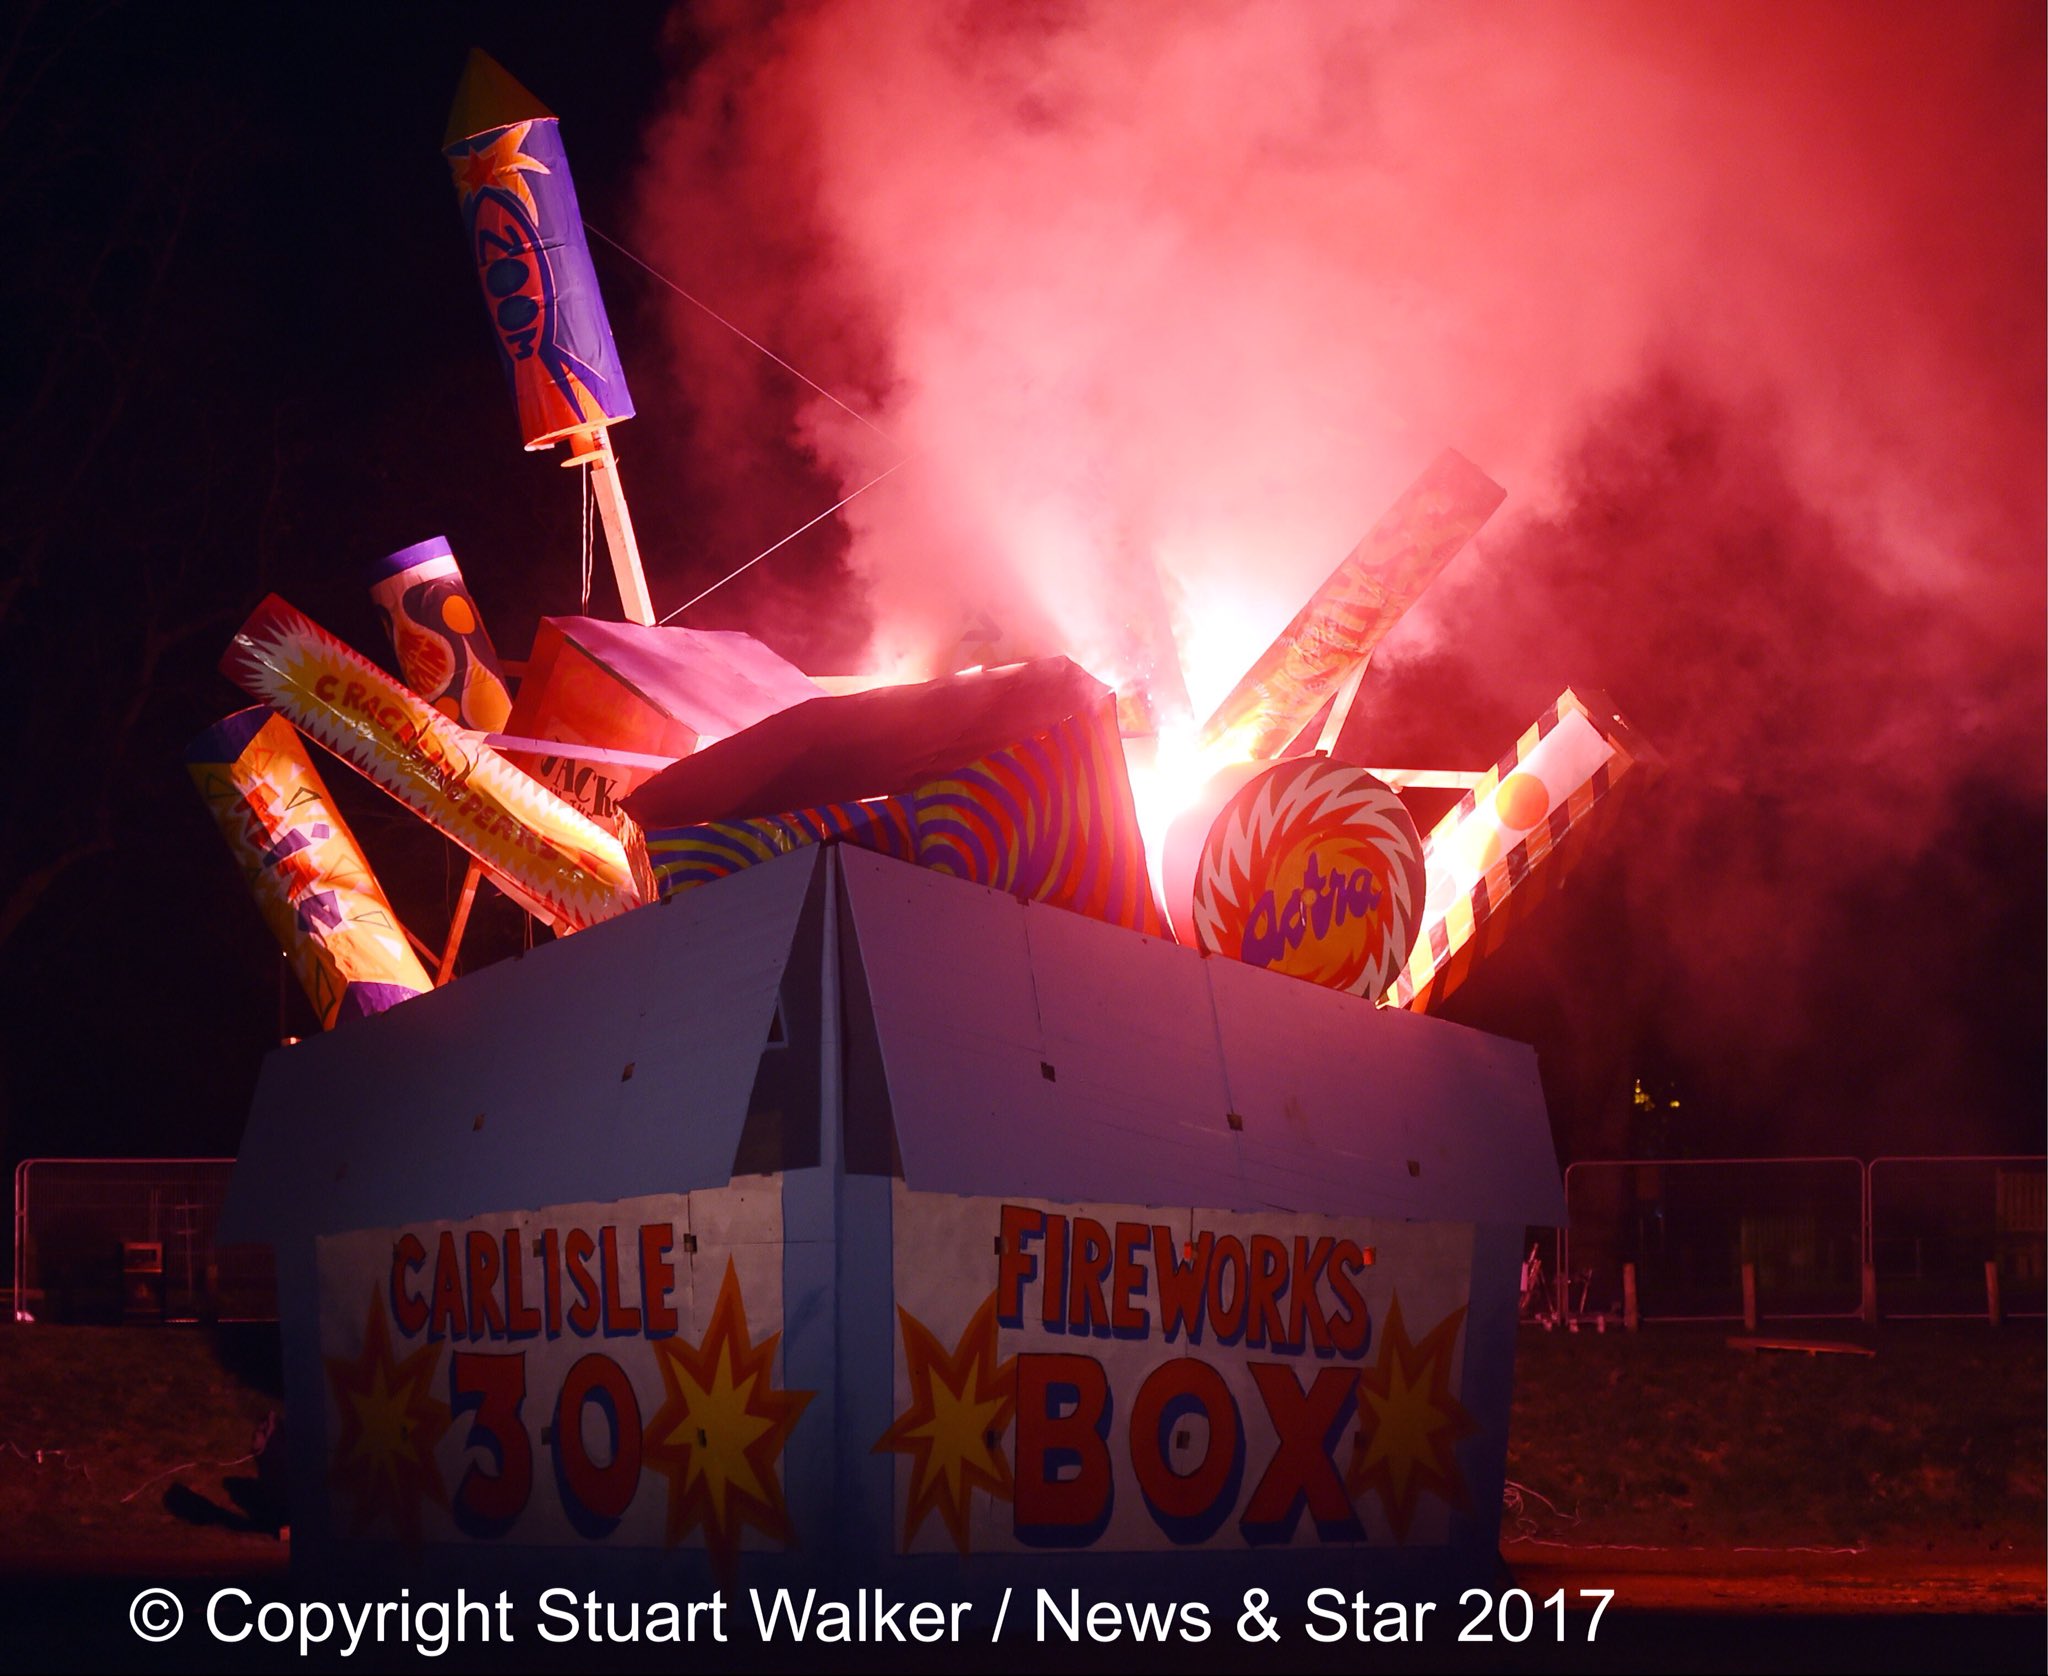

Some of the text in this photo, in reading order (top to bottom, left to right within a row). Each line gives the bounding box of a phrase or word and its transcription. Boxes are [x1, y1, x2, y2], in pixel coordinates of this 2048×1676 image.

[478, 223, 540, 362] ZOOM
[541, 736, 618, 819] JACK
[390, 1222, 679, 1342] CARLISLE
[996, 1204, 1372, 1360] FIREWORKS
[450, 1350, 643, 1540] 30
[1012, 1352, 1368, 1548] BOX
